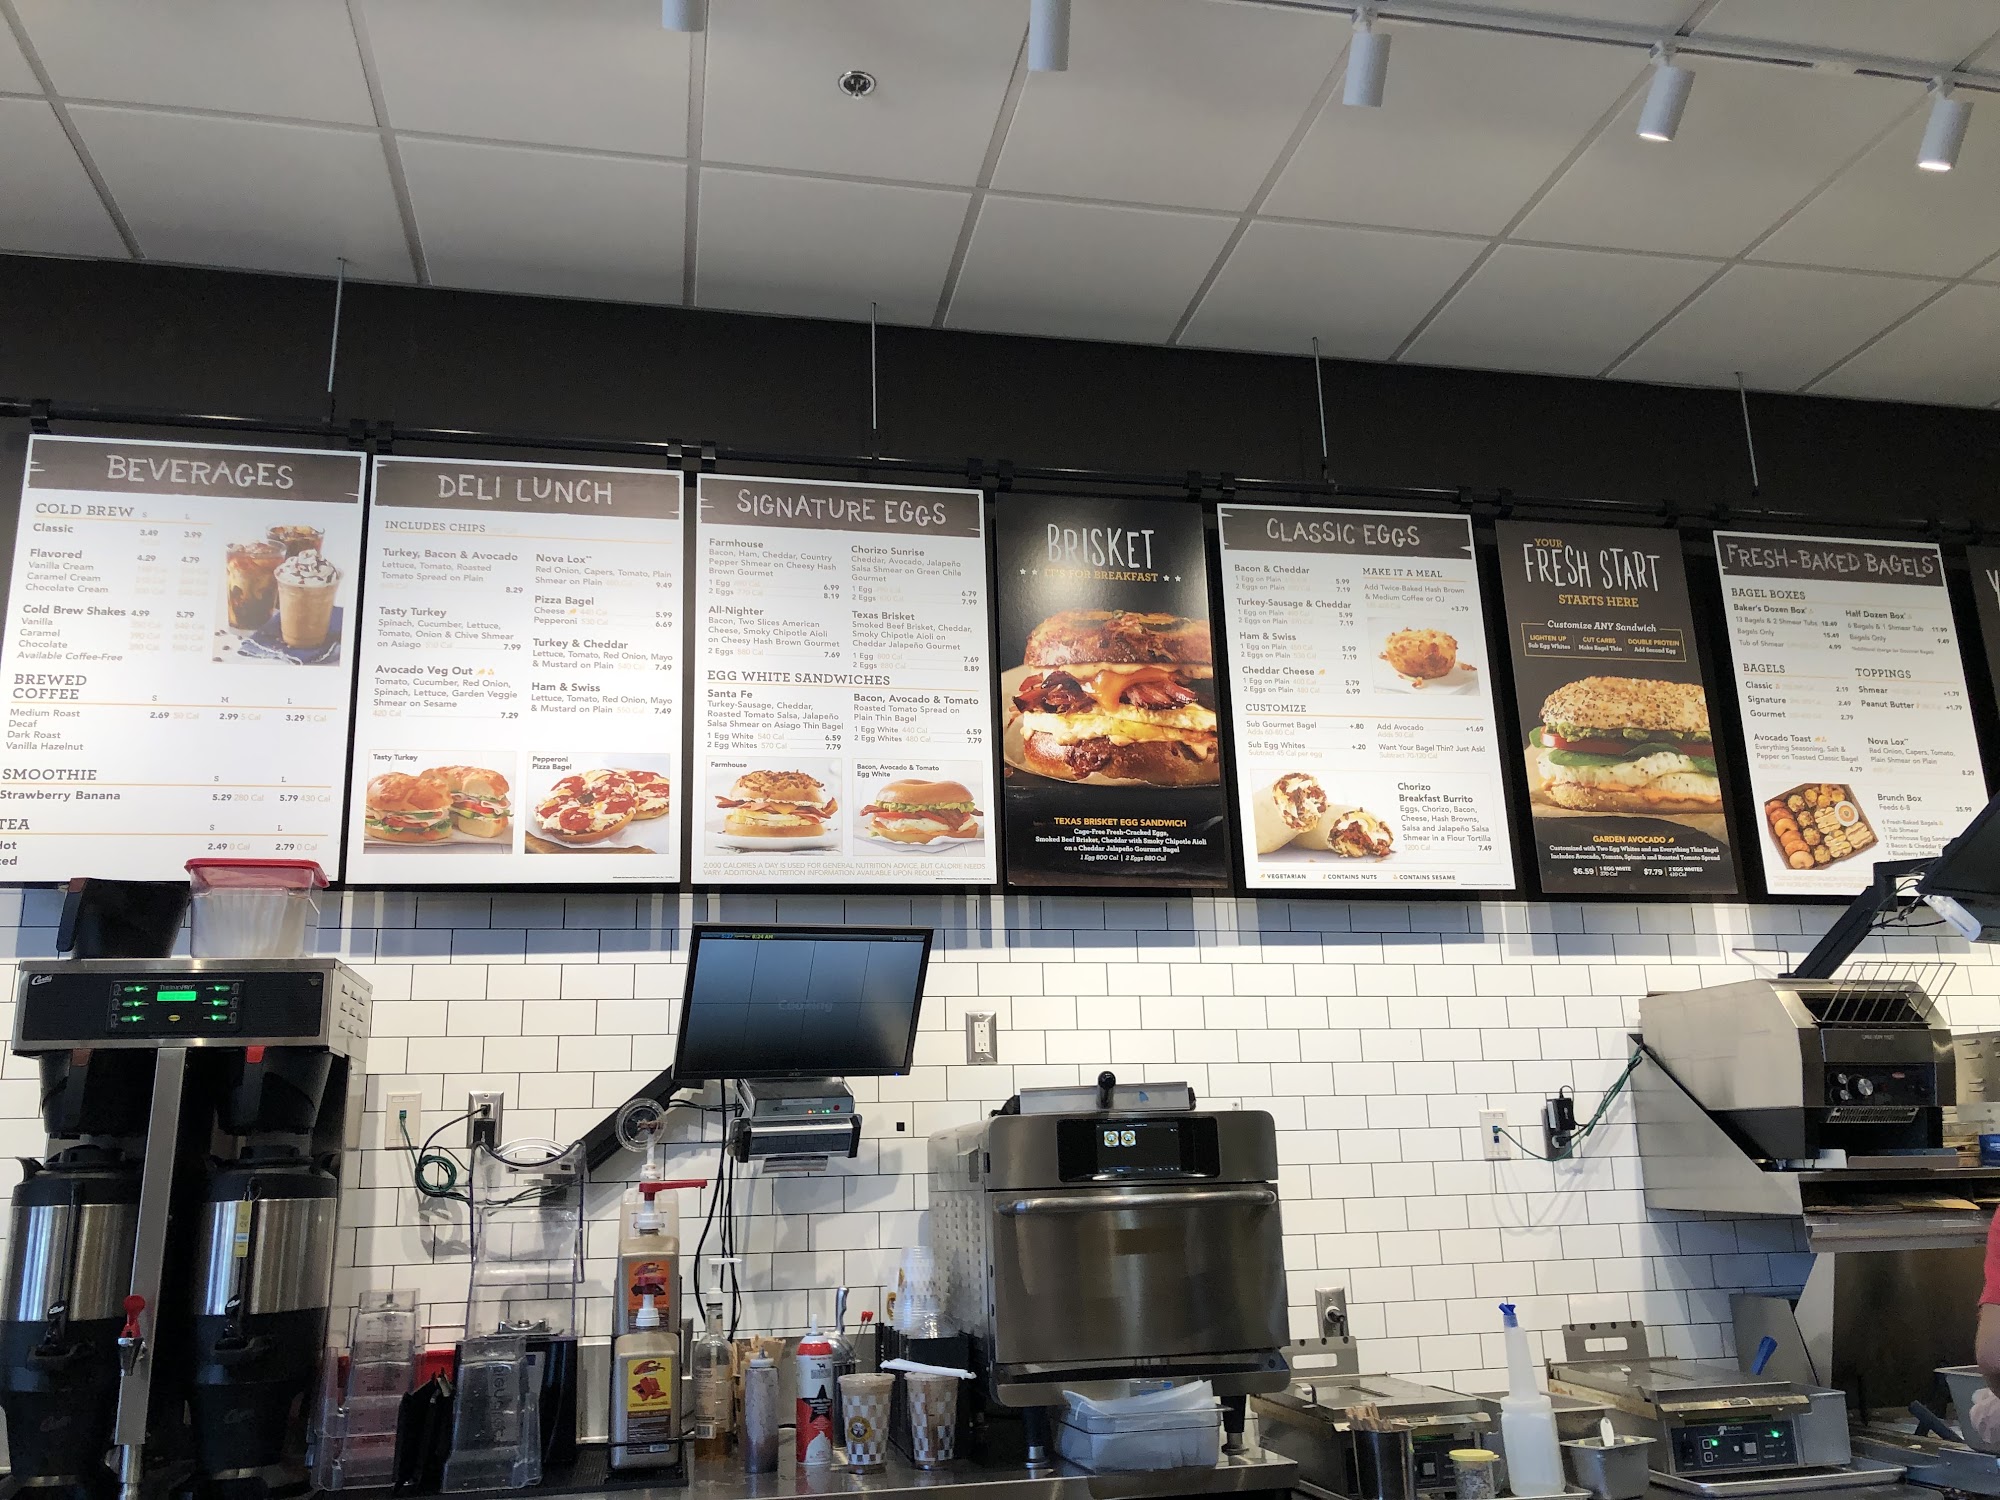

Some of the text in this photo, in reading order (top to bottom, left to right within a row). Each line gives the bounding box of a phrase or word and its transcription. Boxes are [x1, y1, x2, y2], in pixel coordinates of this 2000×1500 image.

[106, 454, 294, 489] BEVERAGES
[438, 474, 612, 504] DELI LUNCH
[36, 503, 134, 516] COLD BREW
[737, 489, 945, 526] SIGNATURE EGGS
[33, 523, 73, 532] Classic
[385, 520, 446, 531] INCLUDES
[449, 523, 485, 532] CHIPS
[1266, 518, 1419, 547] CLASSIC EGGS
[709, 538, 763, 548] Farmhouse
[1047, 524, 1154, 569] BRISKET
[1534, 538, 1563, 548] YOUR
[30, 548, 82, 558] Flavored
[382, 548, 517, 560] Turkey, Bacon & Avocado
[851, 545, 924, 556] Chorizo Sunrise
[536, 554, 563, 562] Nova
[1726, 543, 1934, 578] FRESH-BAKED BAGELS
[1273, 565, 1309, 573] Cheddar
[1523, 544, 1660, 592] FRESH START
[1731, 588, 1805, 599] BAGEL BOXES
[534, 595, 594, 607] Pizza Bagel
[1558, 594, 1638, 607] STARTS HERE
[23, 604, 125, 616] Cold Brew Shakes
[379, 607, 447, 618] Tasty Turkey
[708, 605, 763, 616] All-Nighter
[852, 610, 914, 620] Texas Brisket
[1547, 620, 1656, 631] Customize ANY Sandwich
[1272, 632, 1296, 640] Swiss
[533, 638, 628, 649] Turkey & Cheddar
[375, 665, 472, 676] Avocado Veg Out
[1242, 666, 1314, 675] Cheddar Cheese
[1743, 663, 1785, 673] BAGELS
[1855, 668, 1911, 678] TOPPINGS
[14, 673, 86, 685] BREWED
[707, 670, 890, 685] EGG WHITE SANDWICHES
[532, 682, 600, 691] Ham & Swiss
[1858, 685, 1887, 693] Shmear
[13, 687, 78, 699] COFFEE
[707, 689, 752, 698] Santa Fe
[854, 694, 885, 704] Bacon,
[889, 695, 930, 704] Avocado
[943, 696, 978, 704] Tomato
[1747, 695, 1786, 704] Signature
[10, 708, 49, 716] Medium
[1246, 704, 1306, 713] CUSTOMIZE
[1750, 709, 1785, 717] Gourmet
[8, 719, 37, 727] Decaf
[895, 714, 916, 723] Bagel
[1247, 720, 1316, 730] Sub Gourmet Bagel
[7, 730, 60, 738] Dark Roast
[1754, 733, 1811, 742] Avocado Toast
[40, 742, 83, 750] Hazelnut
[2, 768, 96, 780] SMOOTHIE
[1397, 782, 1430, 790] Chorizo
[0, 790, 120, 801] Strawberry Banana
[1399, 794, 1472, 802] Breakfast Burrito
[1573, 867, 1594, 875] $6.59
[1644, 868, 1663, 876] $7.79
